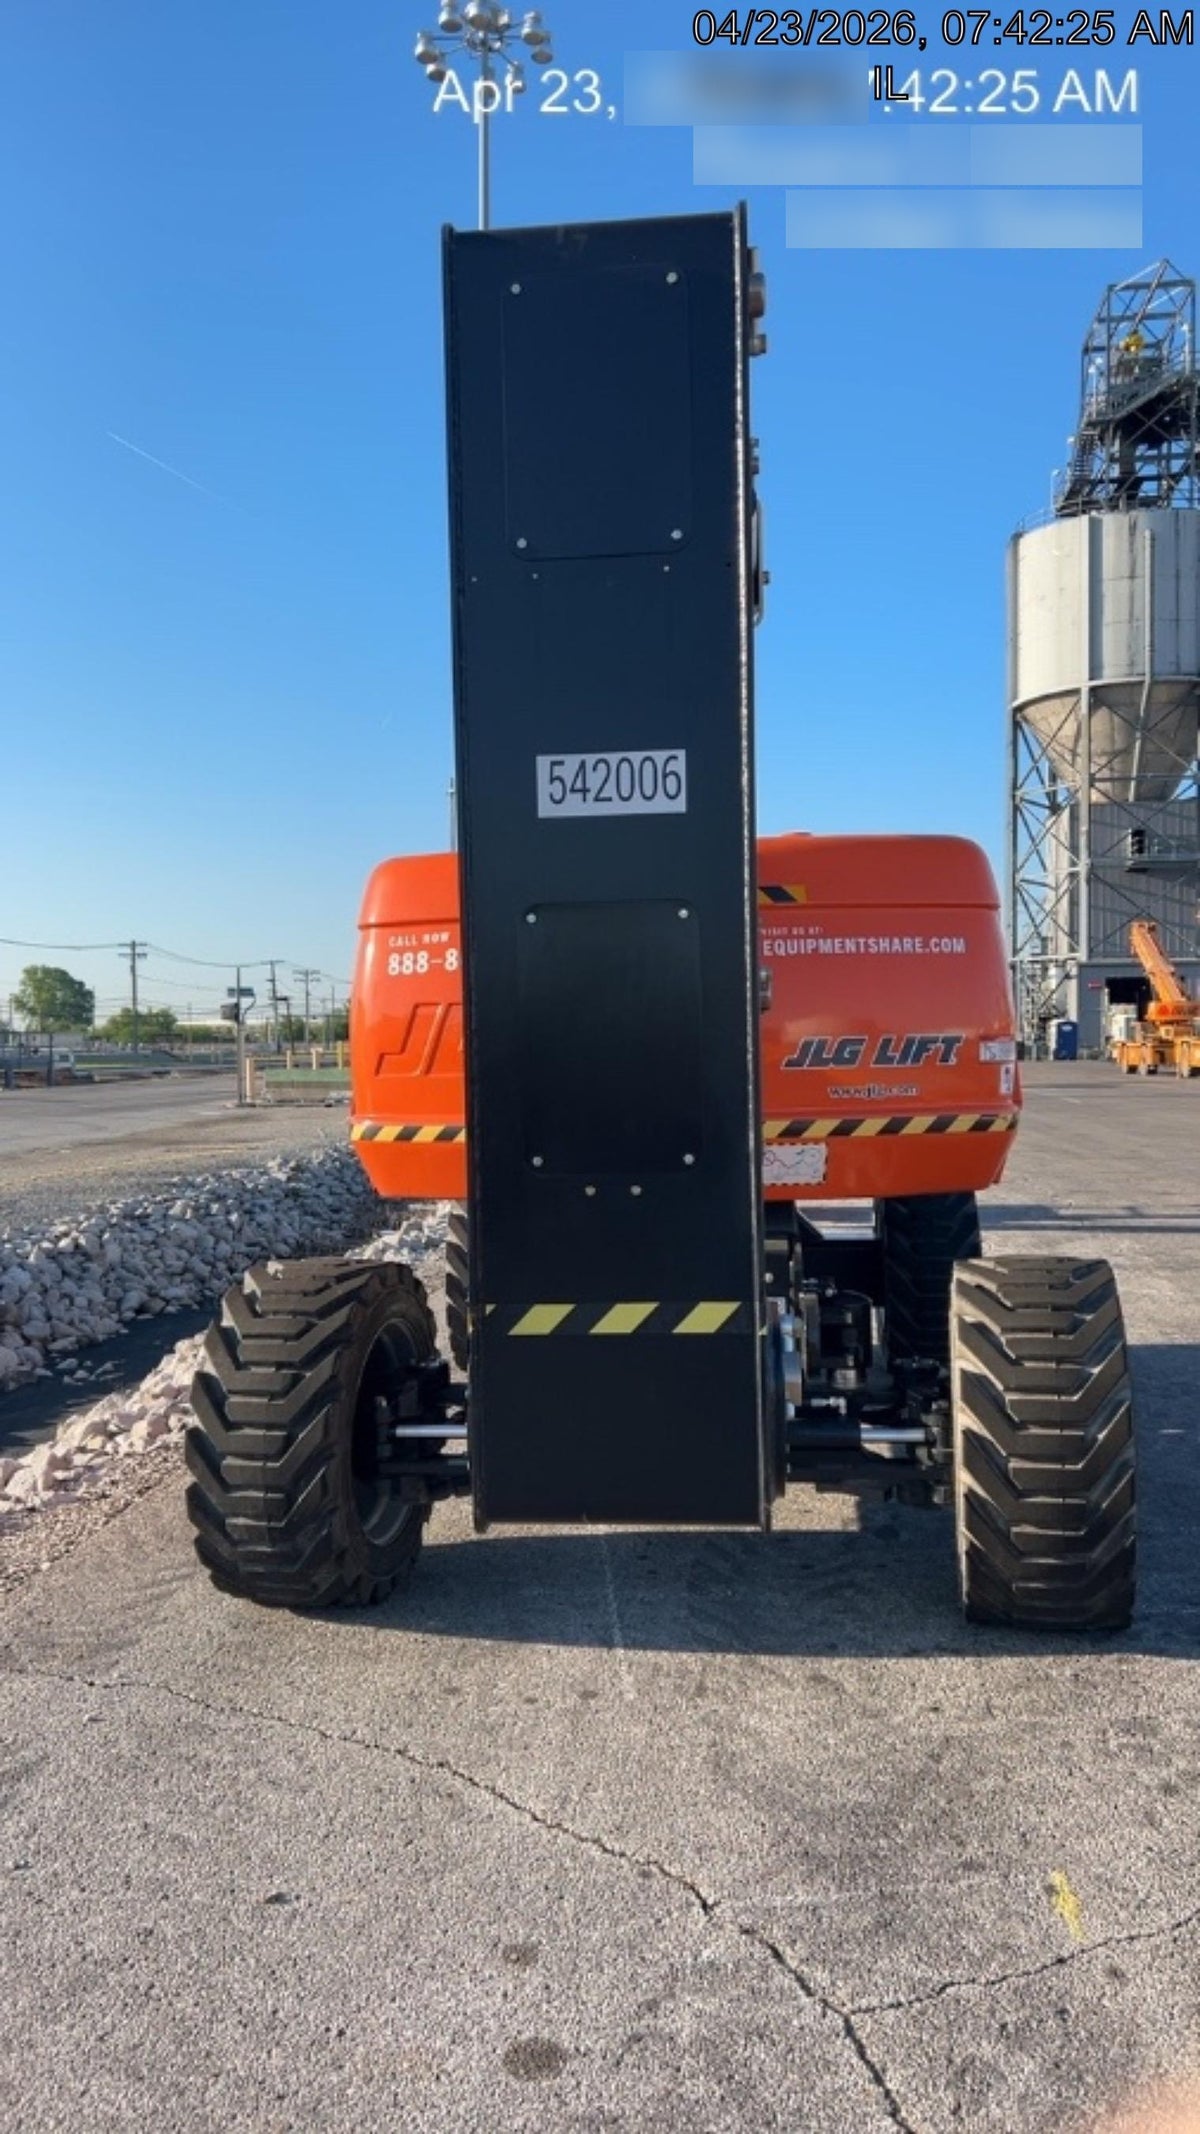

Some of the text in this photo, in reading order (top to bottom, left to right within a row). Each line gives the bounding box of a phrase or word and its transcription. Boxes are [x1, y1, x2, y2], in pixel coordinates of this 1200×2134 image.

[549, 754, 682, 805] 542006
[388, 934, 418, 948] CALL
[762, 936, 967, 957] EQUIPMENTSHARE.COM
[388, 948, 459, 976] 888-8
[780, 1035, 869, 1070] JLG
[870, 1032, 966, 1068] LIFT
